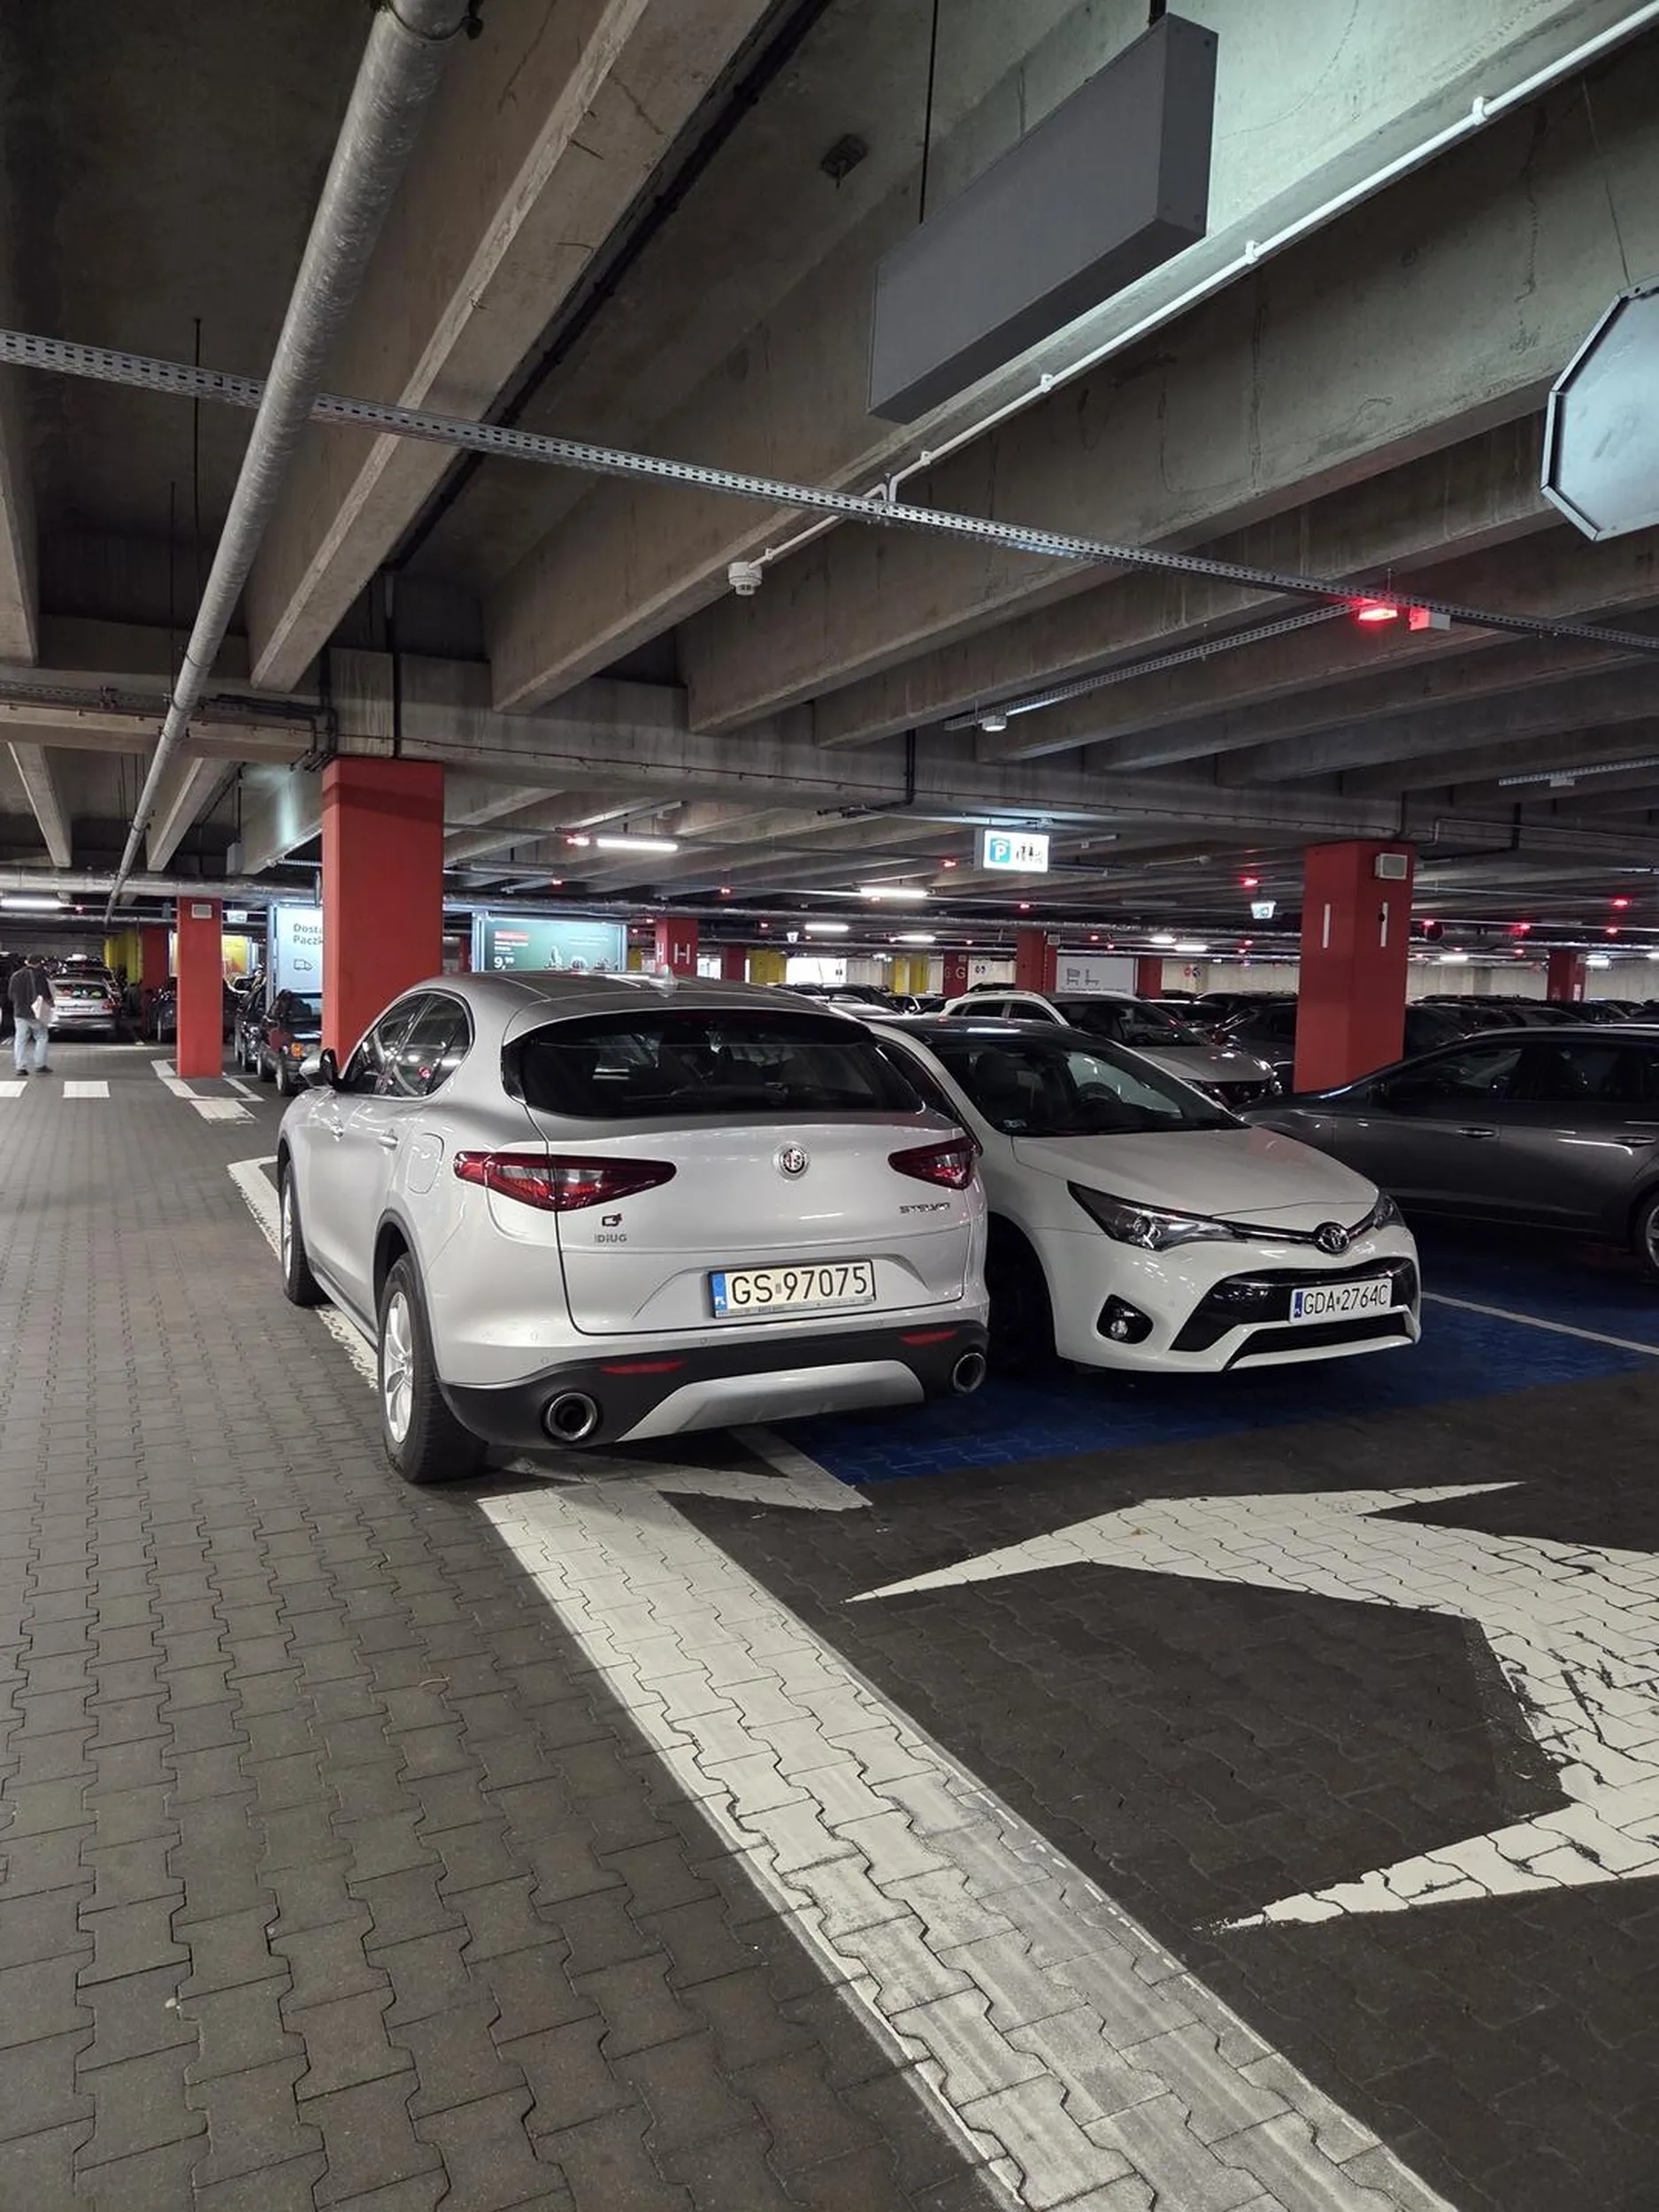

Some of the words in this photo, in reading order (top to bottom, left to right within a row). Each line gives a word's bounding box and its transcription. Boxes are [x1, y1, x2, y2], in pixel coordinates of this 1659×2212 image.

[674, 942, 690, 964] H
[732, 1274, 772, 1305] GS
[783, 1266, 868, 1302] 97075
[1303, 1290, 1336, 1315] GDA
[1340, 1285, 1388, 1310] 2764C
